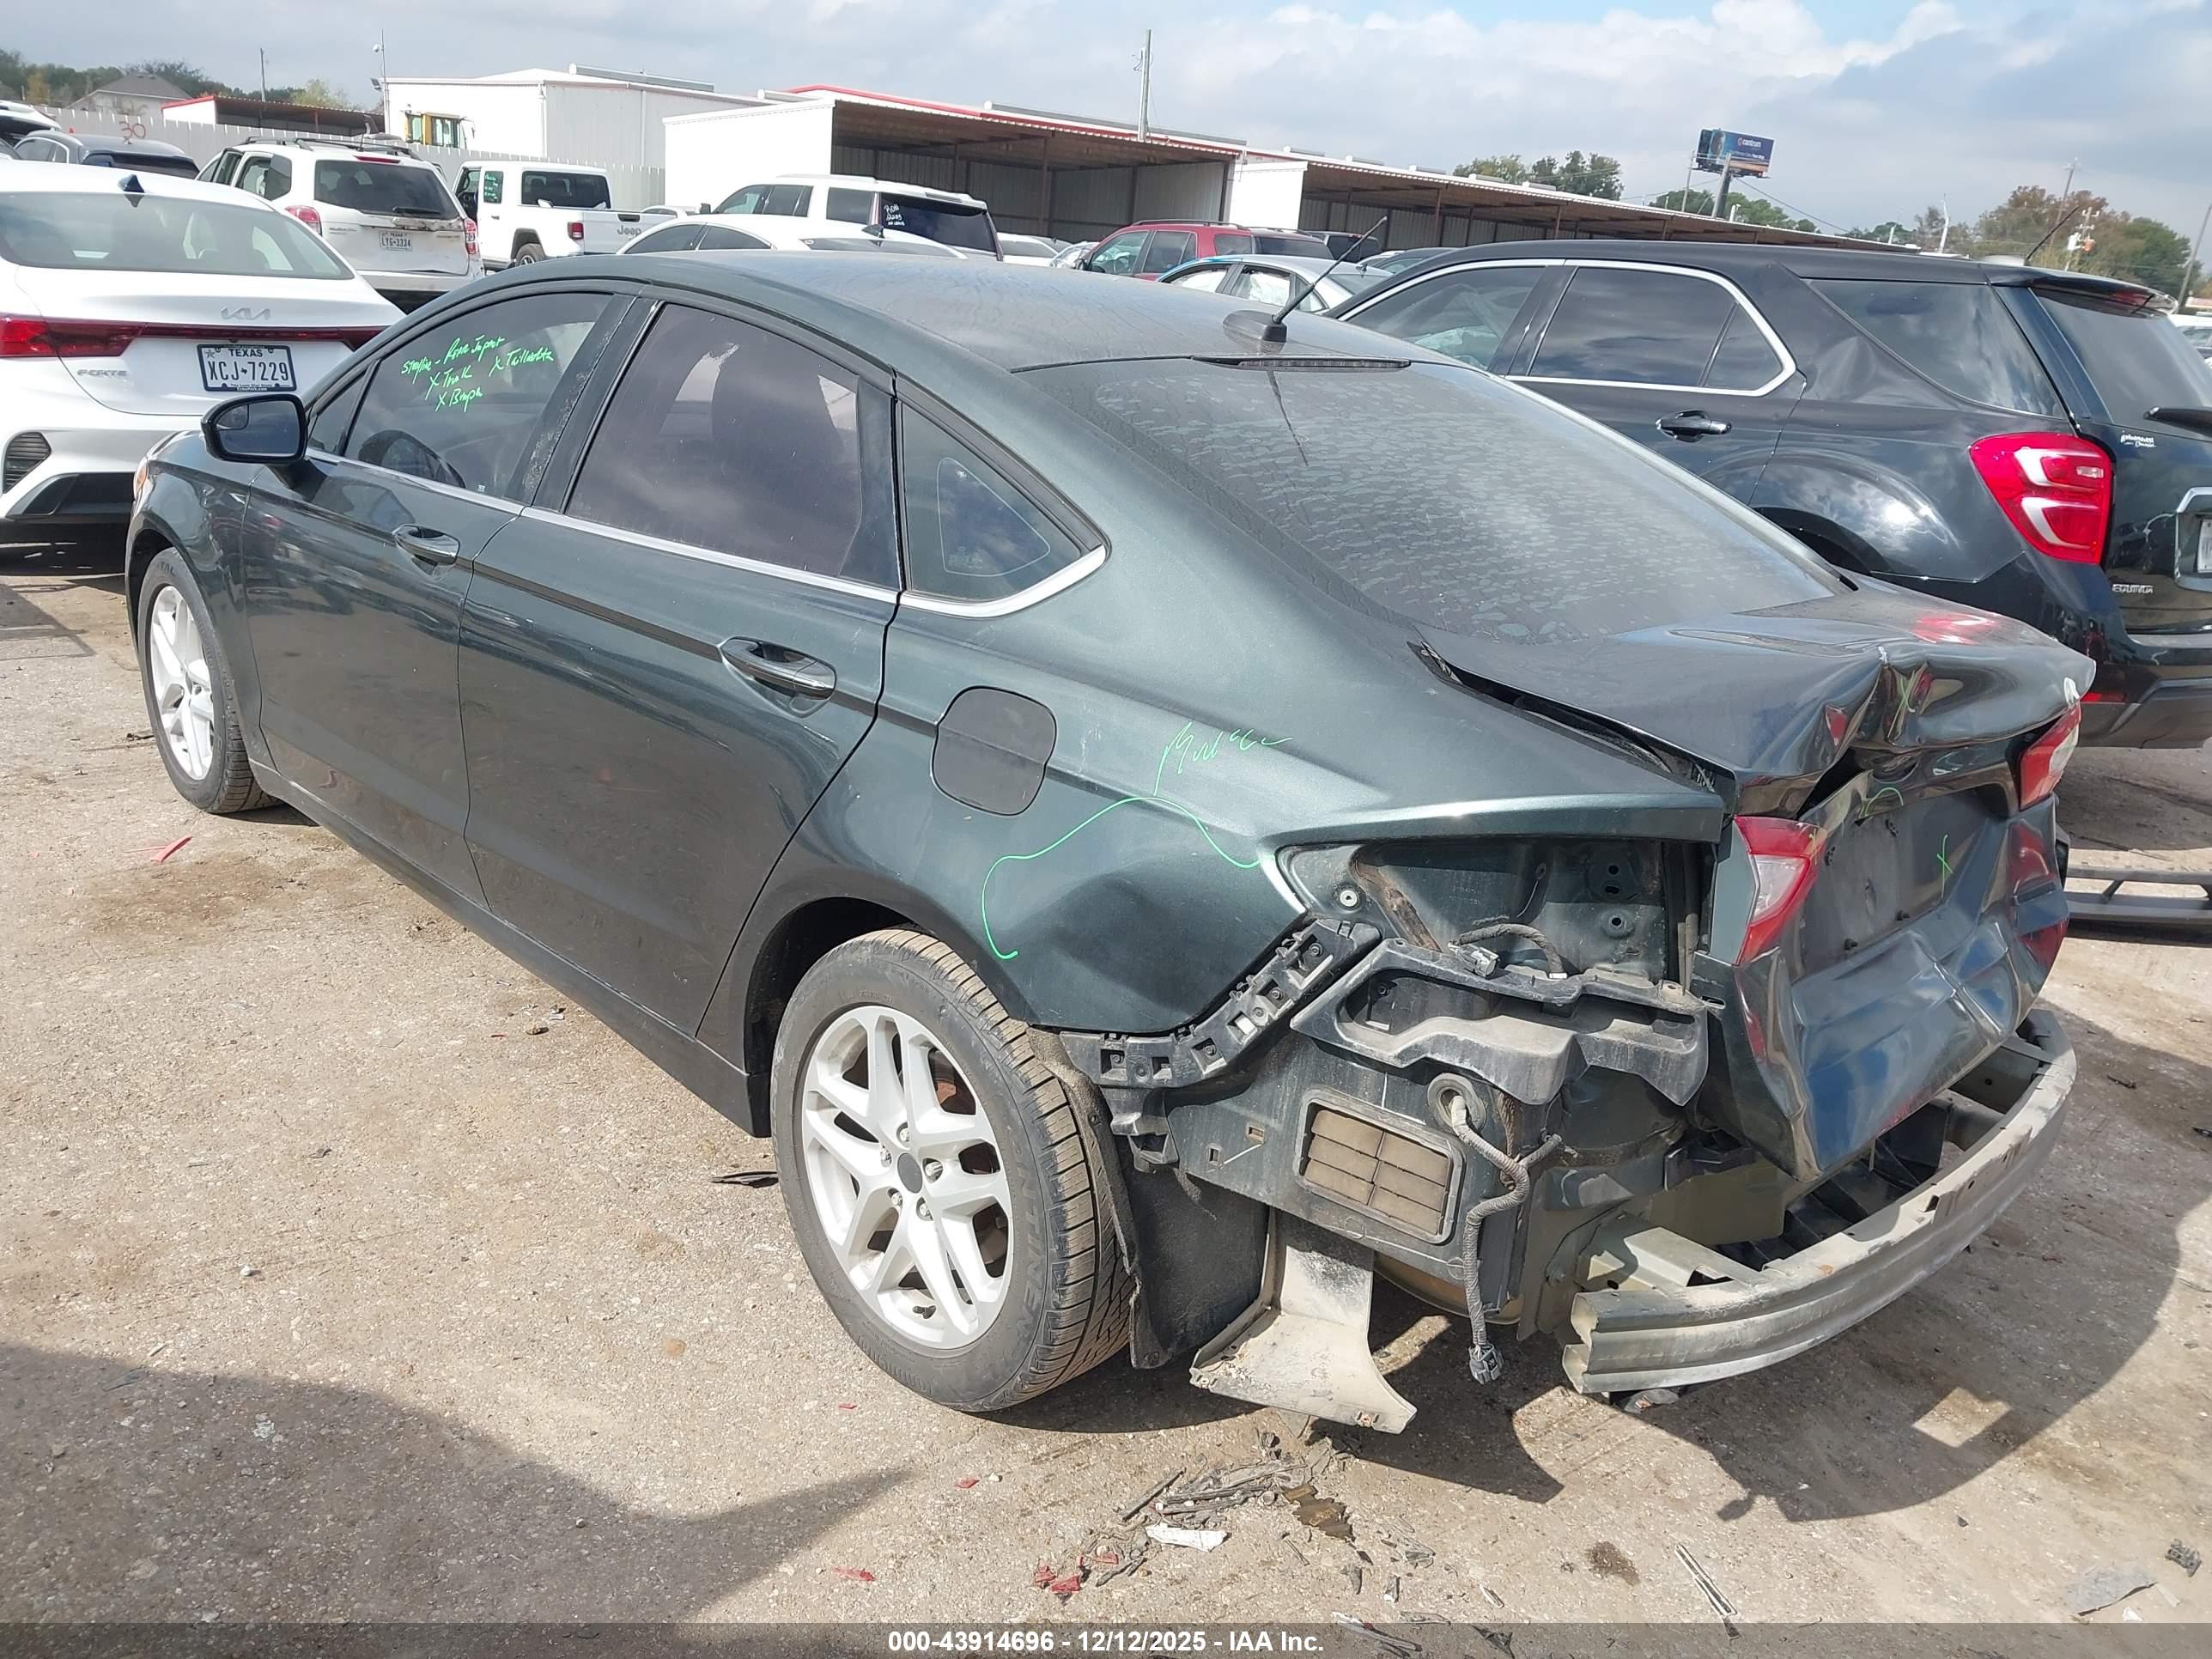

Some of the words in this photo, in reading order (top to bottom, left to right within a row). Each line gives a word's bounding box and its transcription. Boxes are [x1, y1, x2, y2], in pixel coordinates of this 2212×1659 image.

[617, 226, 642, 237] Jeep
[228, 349, 264, 358] TEXAS
[2112, 583, 2154, 594] EQUINOX
